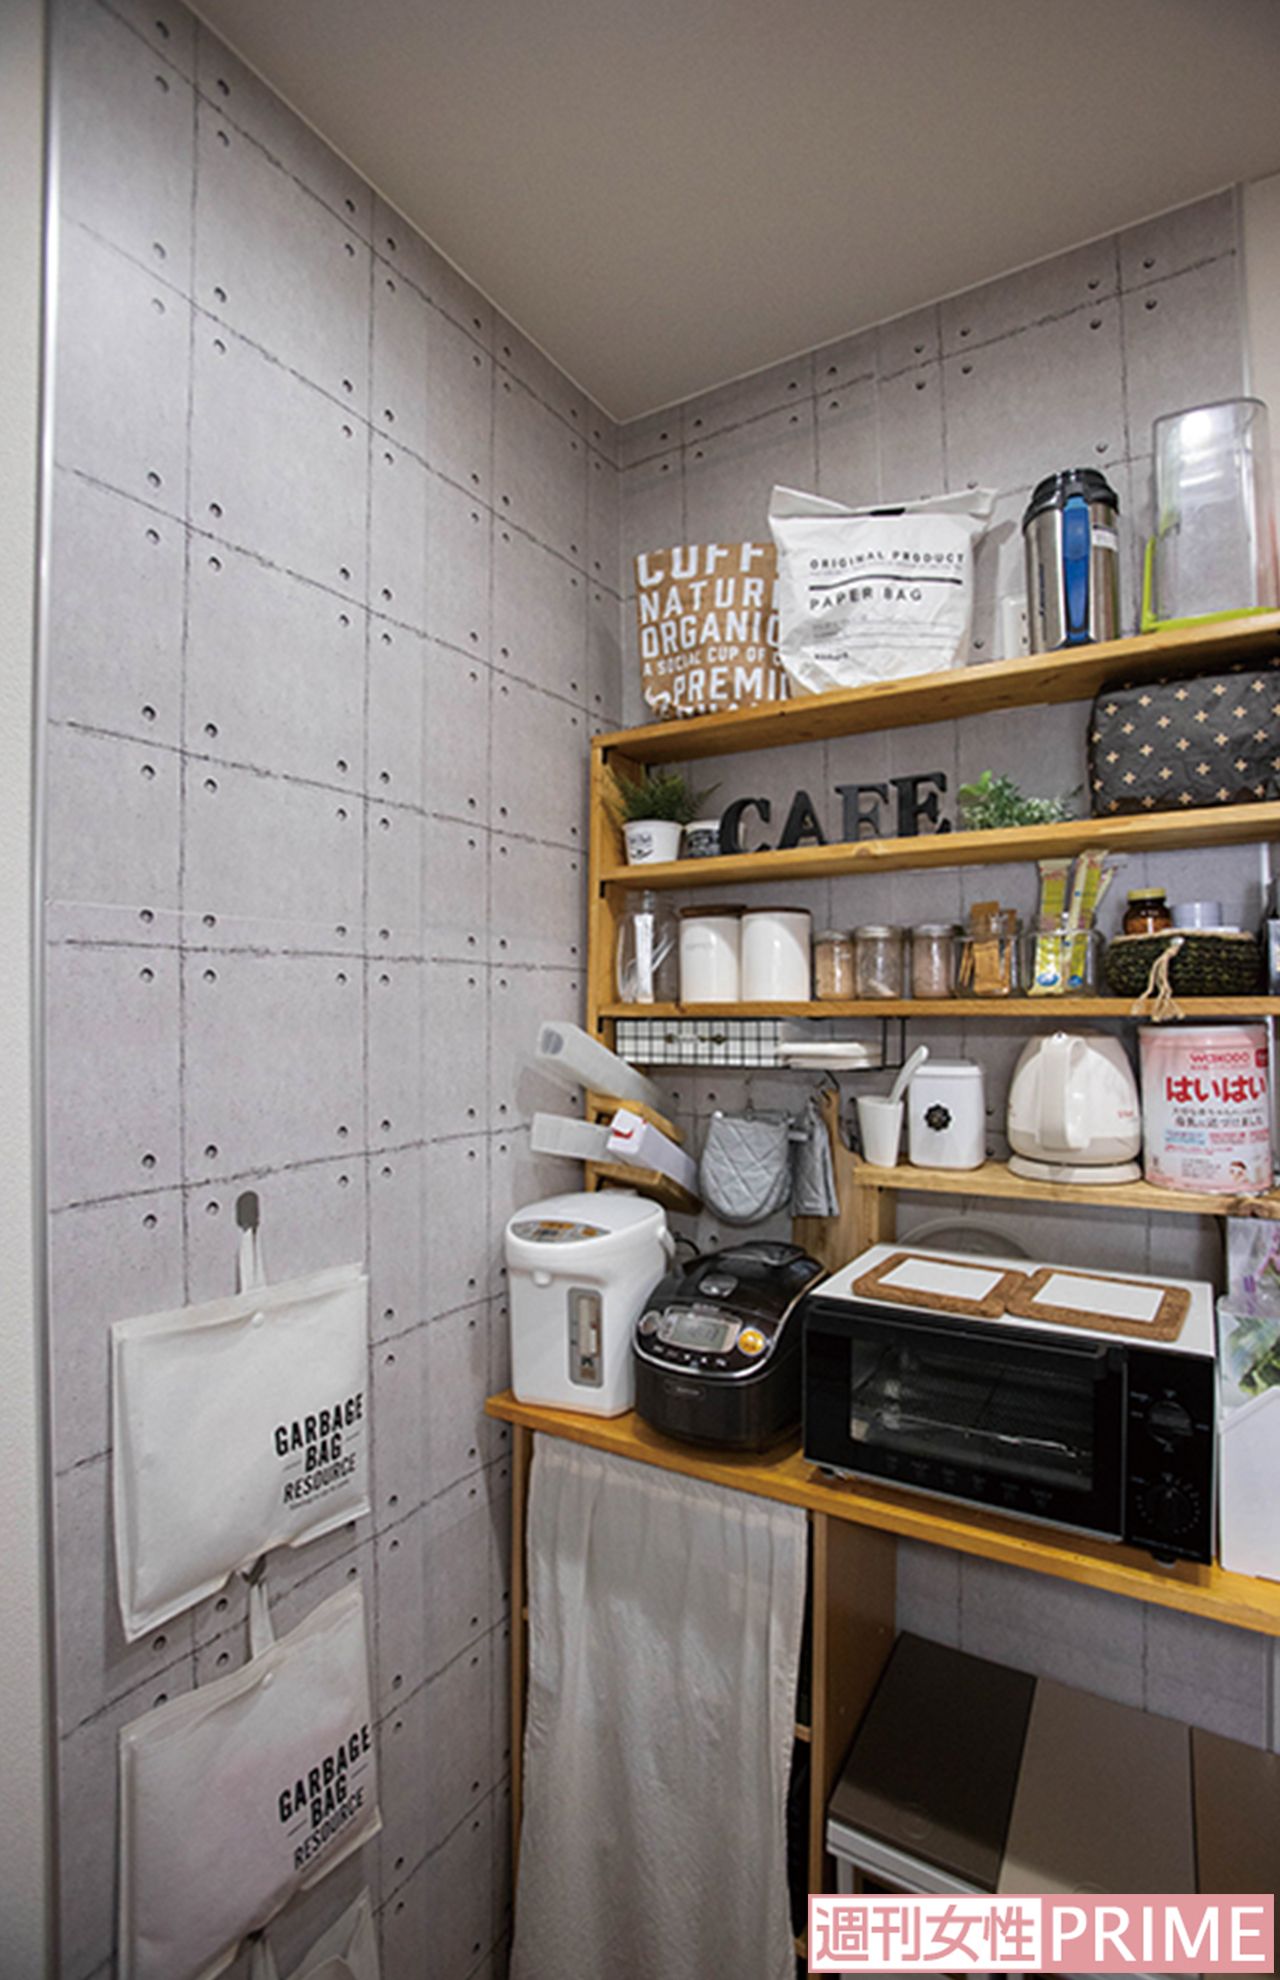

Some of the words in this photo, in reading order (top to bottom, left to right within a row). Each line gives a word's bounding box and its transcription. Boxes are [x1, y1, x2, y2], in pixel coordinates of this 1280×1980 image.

[809, 551, 885, 570] ORIGINAL
[892, 551, 964, 564] PRODUCT
[810, 586, 873, 610] PAPER
[883, 587, 923, 601] BAG
[707, 646, 739, 662] CUP
[746, 646, 767, 662] OF
[719, 772, 952, 854] CAFE
[1166, 1075, 1266, 1103] はいはい
[274, 1393, 363, 1457] GARBAGE
[283, 1452, 356, 1504] RESOURCE
[305, 1432, 342, 1473] BAG
[278, 1724, 371, 1823] GARBAGE
[310, 1774, 347, 1829] BAG
[293, 1786, 365, 1870] RESOURCE
